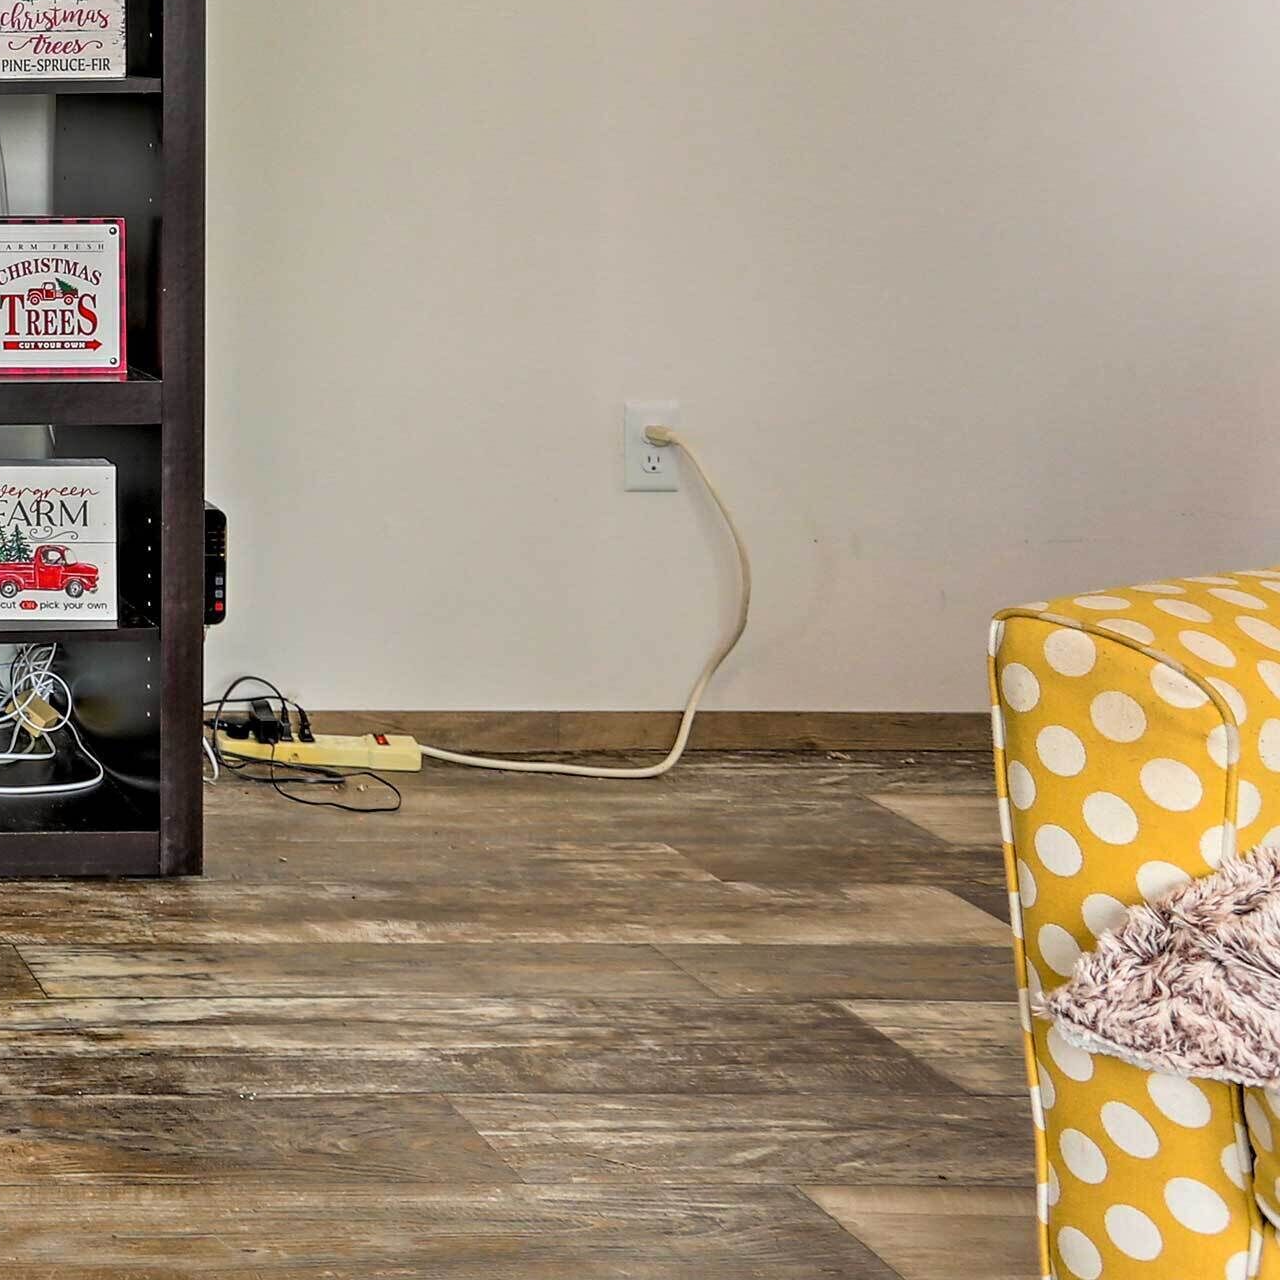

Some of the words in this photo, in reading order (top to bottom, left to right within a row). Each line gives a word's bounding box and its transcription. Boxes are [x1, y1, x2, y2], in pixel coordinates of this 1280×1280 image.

[0, 2, 110, 30] christmas
[8, 34, 103, 54] trees
[1, 58, 111, 72] PINE-SPRUCE-FIR
[0, 293, 98, 336] TREES
[18, 341, 36, 349] CUT
[37, 341, 62, 349] YOUR
[63, 341, 86, 349] OWN
[0, 600, 16, 609] cut
[40, 600, 60, 610] pick
[63, 602, 84, 611] your
